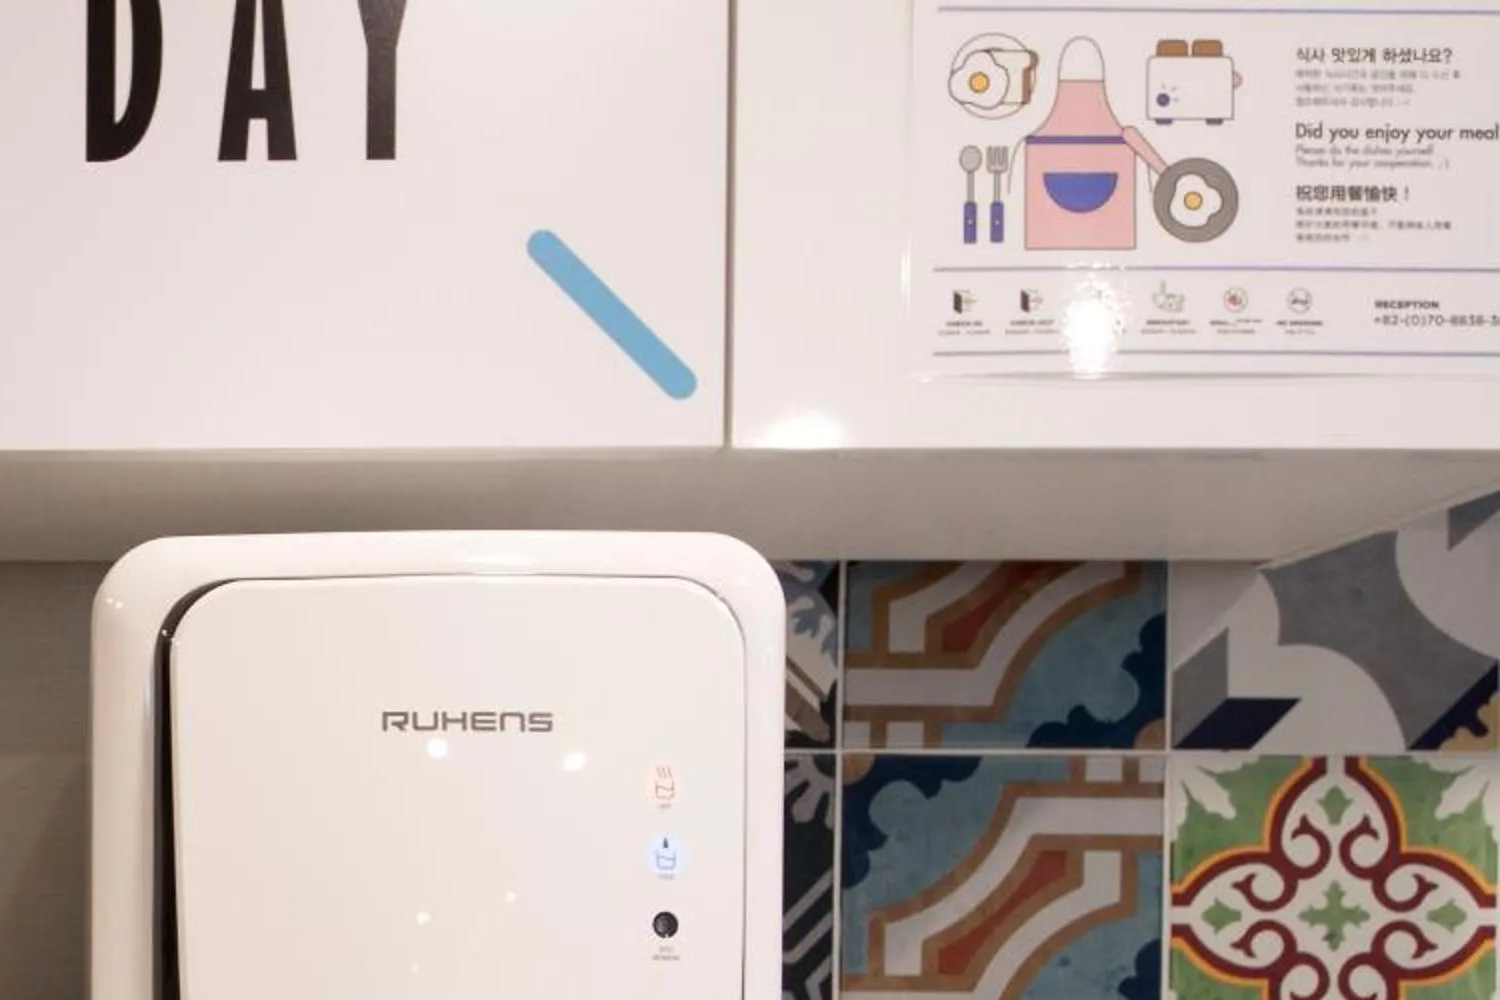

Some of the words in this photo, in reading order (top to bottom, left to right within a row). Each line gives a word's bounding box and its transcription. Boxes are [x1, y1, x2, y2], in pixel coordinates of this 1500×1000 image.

[1296, 48, 1325, 64] 식사
[1331, 48, 1377, 64] 맛있게
[1382, 47, 1453, 65] 하셨나요?
[1295, 122, 1323, 140] Did
[1329, 127, 1359, 144] you
[1365, 122, 1411, 144] enjoy
[1416, 127, 1453, 143] your
[1459, 122, 1500, 140] meal
[1374, 300, 1440, 310] RECEPTION
[382, 711, 553, 732] RUHENS
